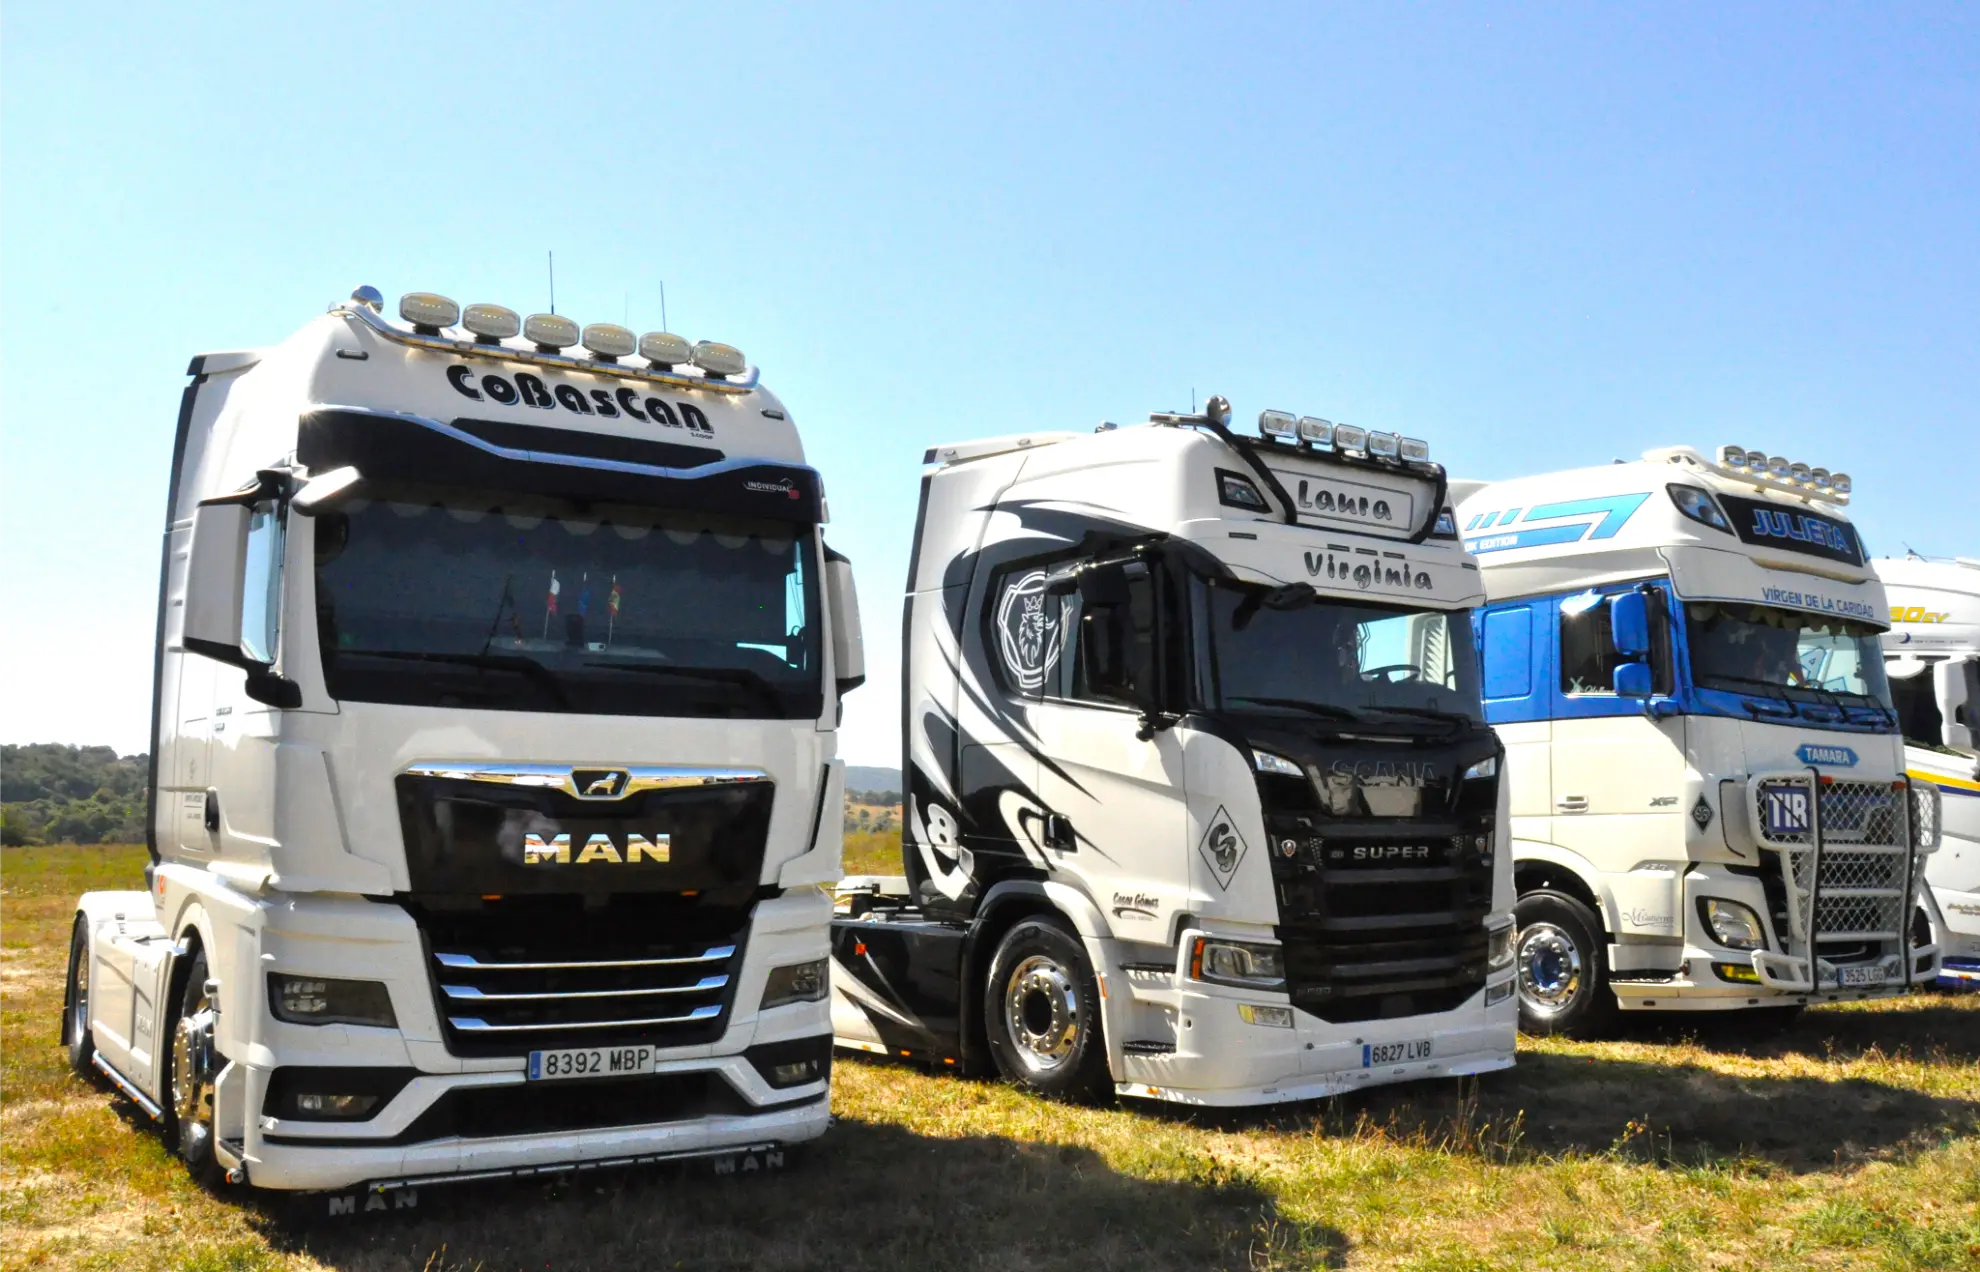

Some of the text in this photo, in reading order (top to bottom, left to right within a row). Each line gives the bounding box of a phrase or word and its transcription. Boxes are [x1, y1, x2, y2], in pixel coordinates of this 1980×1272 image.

[446, 364, 715, 434] CoBasCan
[747, 481, 790, 493] INDIVIDUAL
[1298, 480, 1392, 521] Laura
[1479, 534, 1518, 550] EDITION
[1752, 508, 1852, 554] JULIETA
[1303, 551, 1433, 590] Virginia
[1804, 594, 1818, 608] DE
[1821, 595, 1835, 610] LA
[1837, 600, 1874, 618] CARIDAD
[1805, 747, 1850, 764] TAMARA
[1332, 760, 1440, 787] SCANIA
[1768, 792, 1808, 828] TIR
[524, 833, 671, 864] MAN
[1353, 846, 1429, 860] SUPER
[546, 1048, 649, 1076] 8392 MBP
[1372, 1041, 1431, 1063] 6827 LVB
[714, 1151, 784, 1175] MAN
[329, 1188, 418, 1216] MAN
